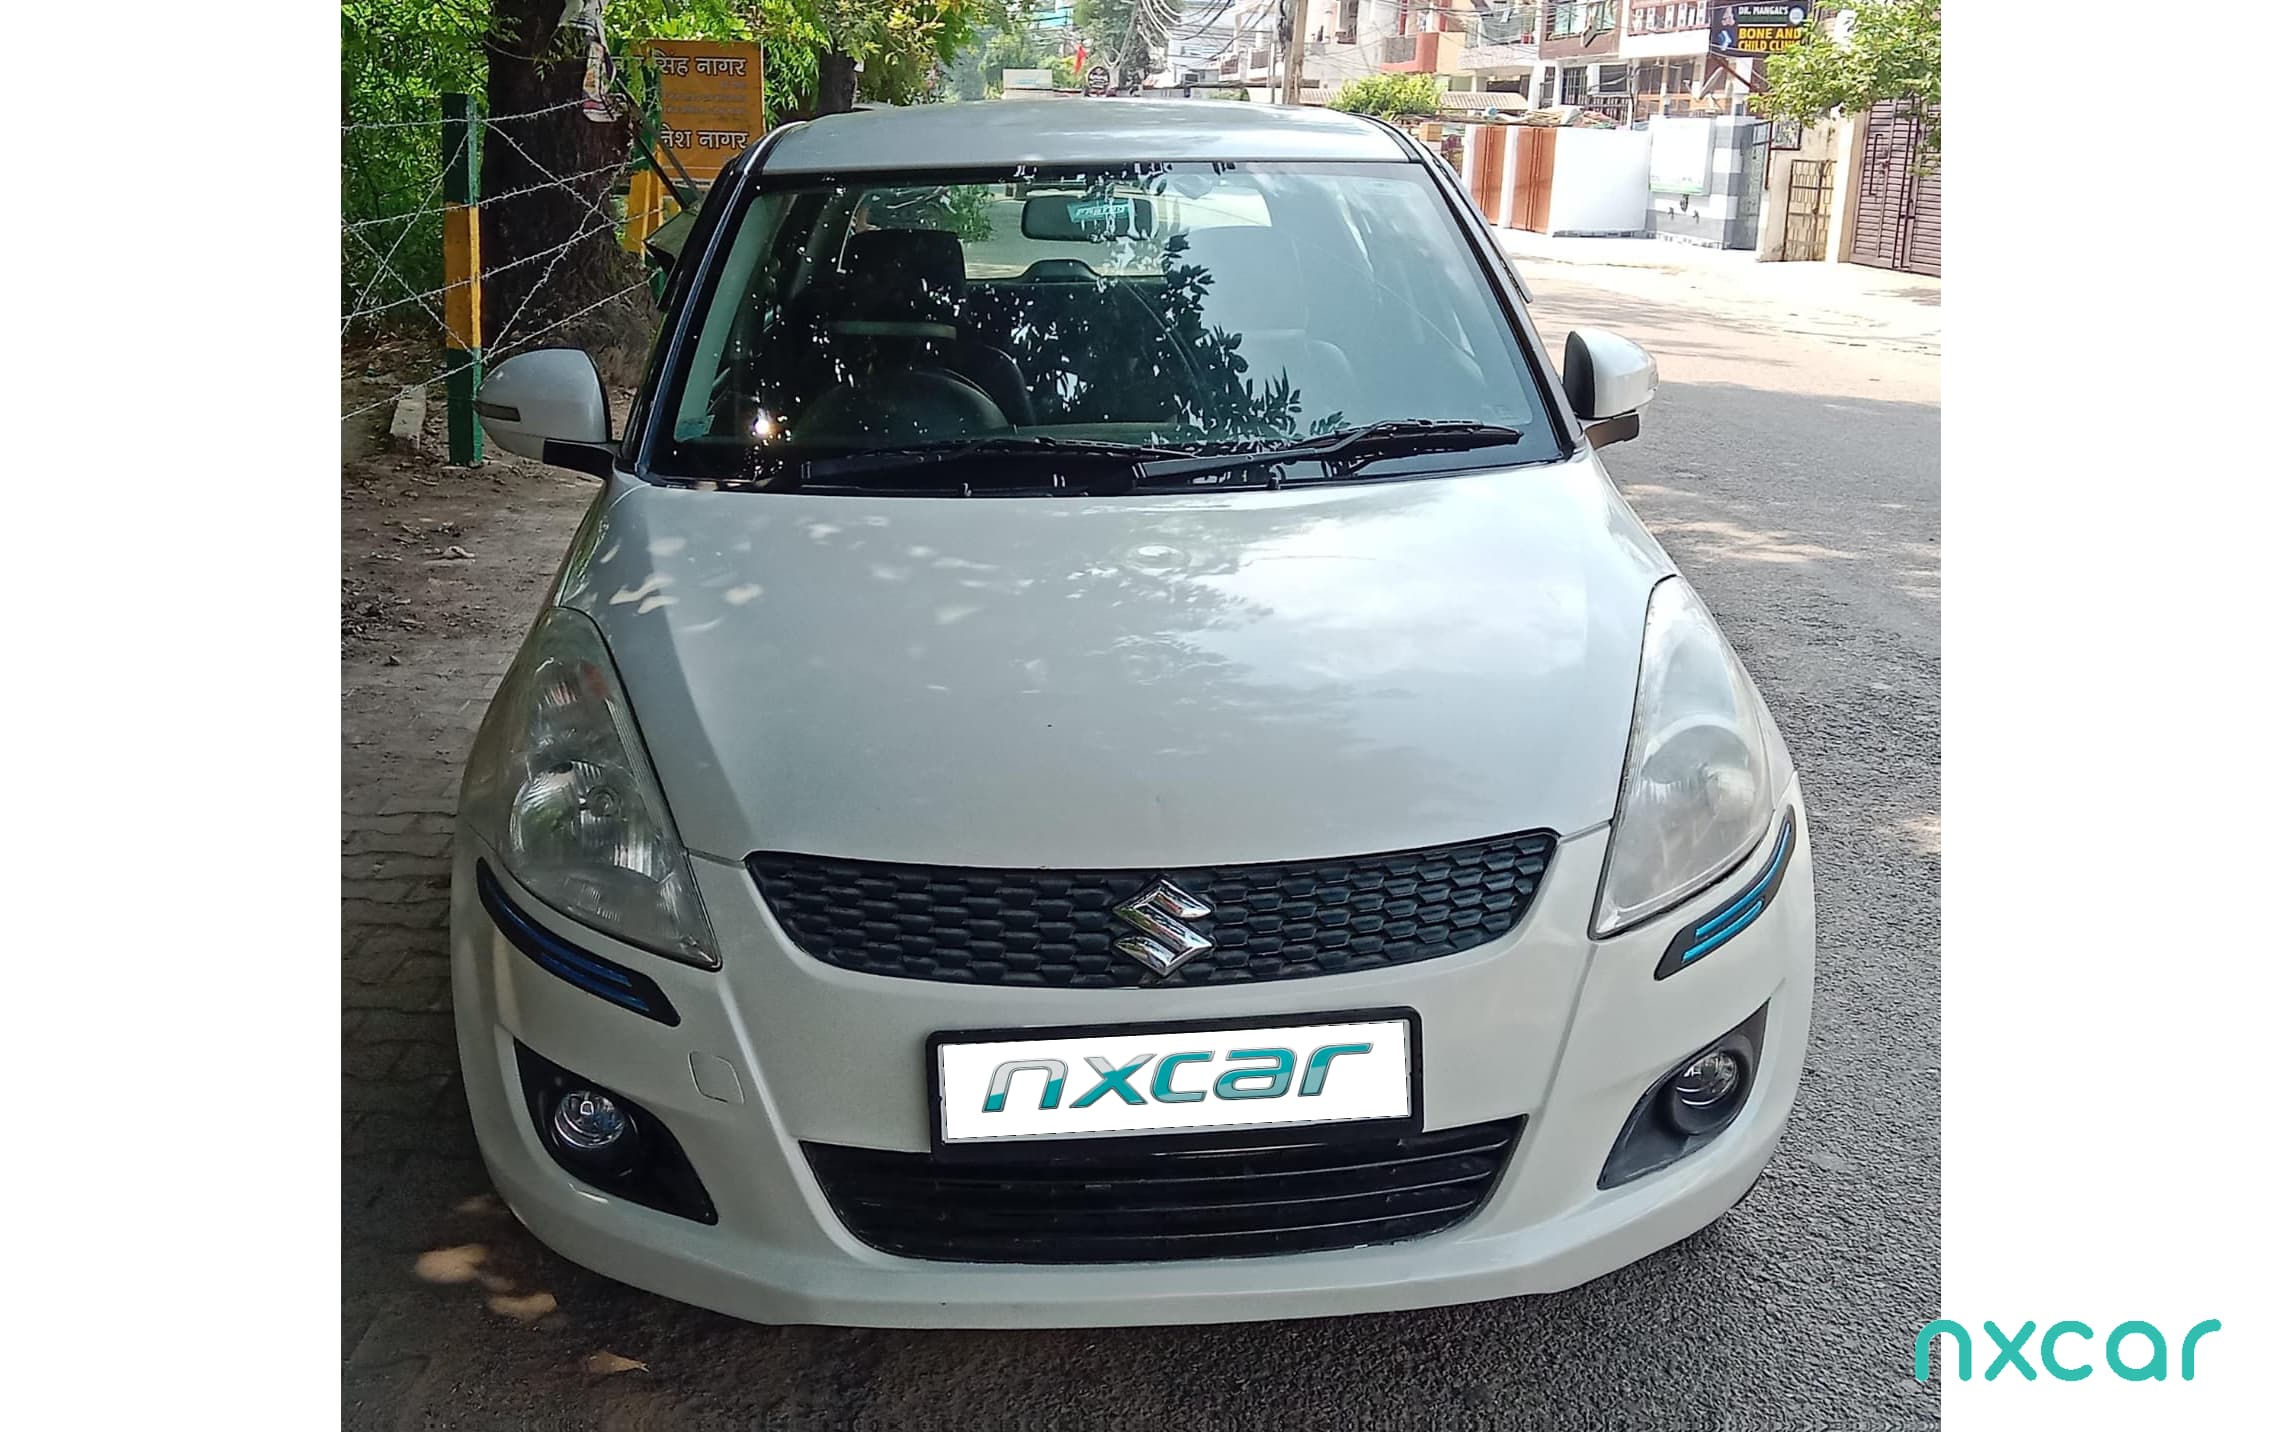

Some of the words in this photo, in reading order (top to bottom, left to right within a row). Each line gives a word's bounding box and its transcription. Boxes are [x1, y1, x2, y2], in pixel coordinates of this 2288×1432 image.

[1738, 27, 1773, 39] BONE
[1775, 27, 1801, 39] AND
[1738, 39, 1767, 51] CHILD
[1769, 39, 1800, 52] CLI
[695, 57, 747, 77] नागर
[697, 130, 749, 150] नागर
